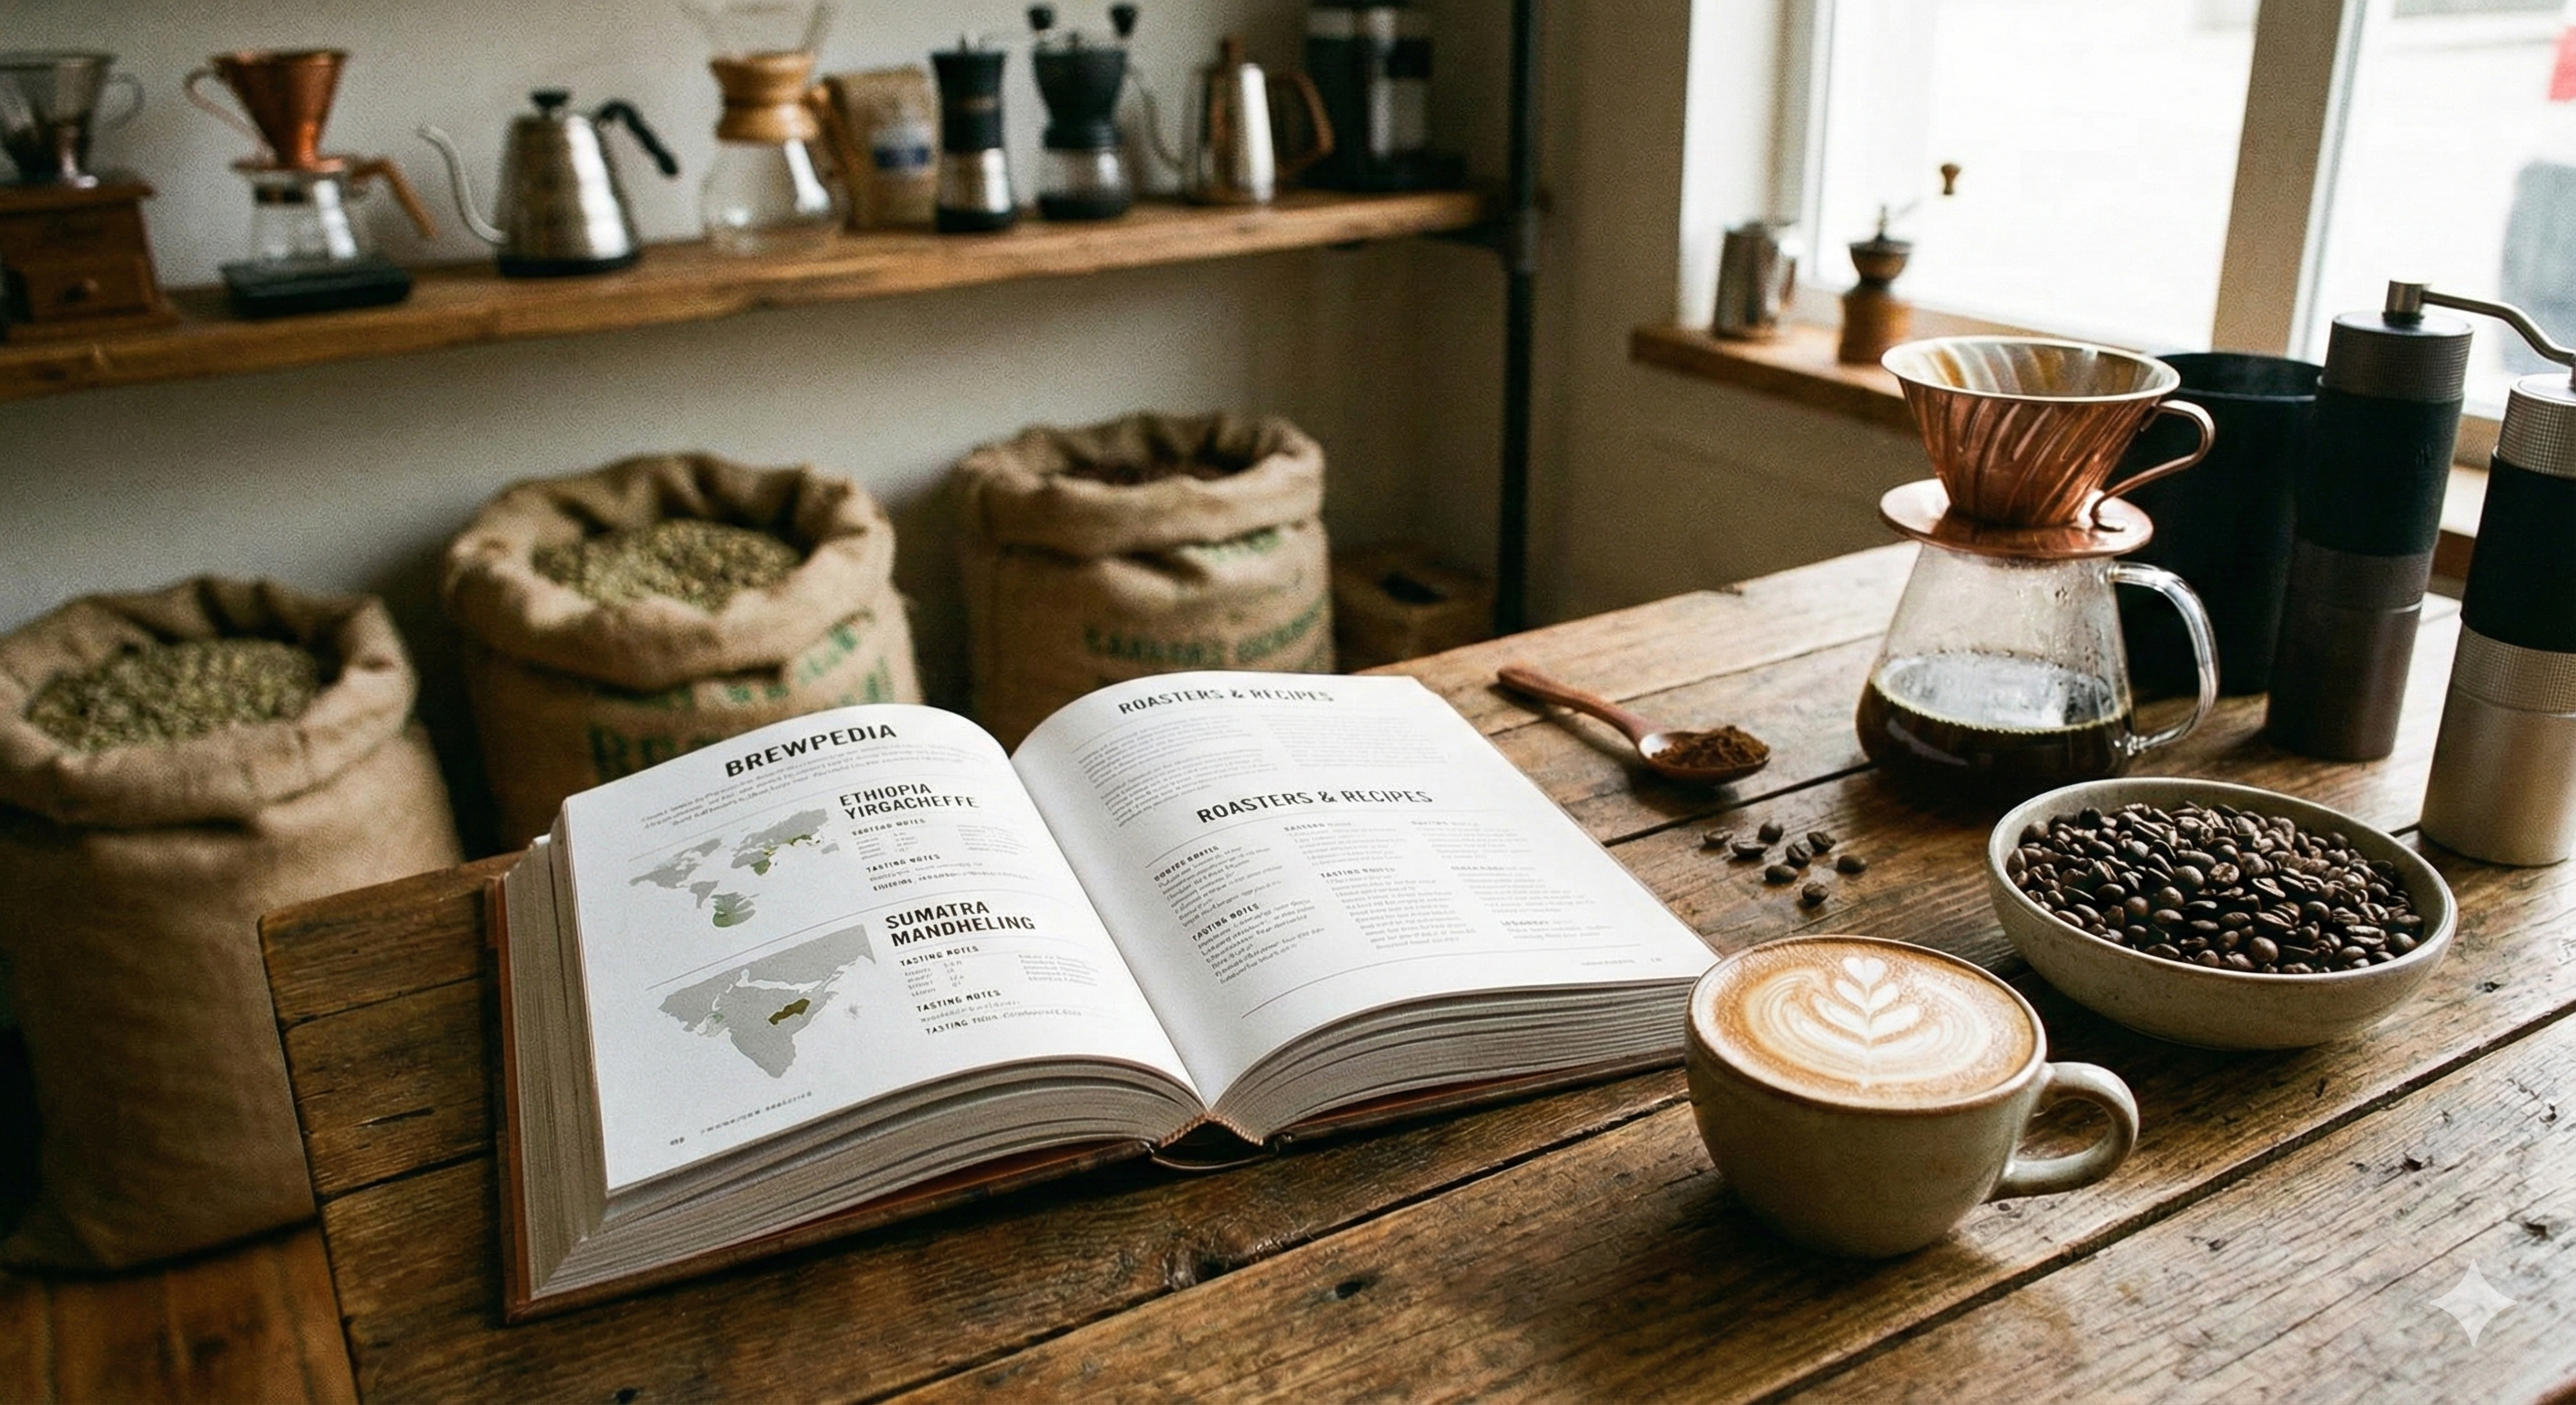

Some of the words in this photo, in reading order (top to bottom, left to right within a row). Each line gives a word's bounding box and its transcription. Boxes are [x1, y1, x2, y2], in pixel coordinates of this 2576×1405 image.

[1118, 689, 1224, 714] ROASTERS
[1229, 689, 1244, 698] &
[1250, 689, 1335, 702] RECIPES
[724, 724, 897, 778] BREWPEDIA
[839, 783, 932, 807] ETHIOPIA
[1197, 792, 1314, 823] ROASTERS
[1317, 790, 1337, 803] &
[1341, 790, 1433, 803] RECIPES
[844, 796, 981, 820] YIRGACHEFFE
[886, 901, 990, 929] SUMATRA
[891, 917, 1036, 947] MANDHELING
[916, 996, 962, 1013] TASTING
[925, 1019, 969, 1035] TASTING
